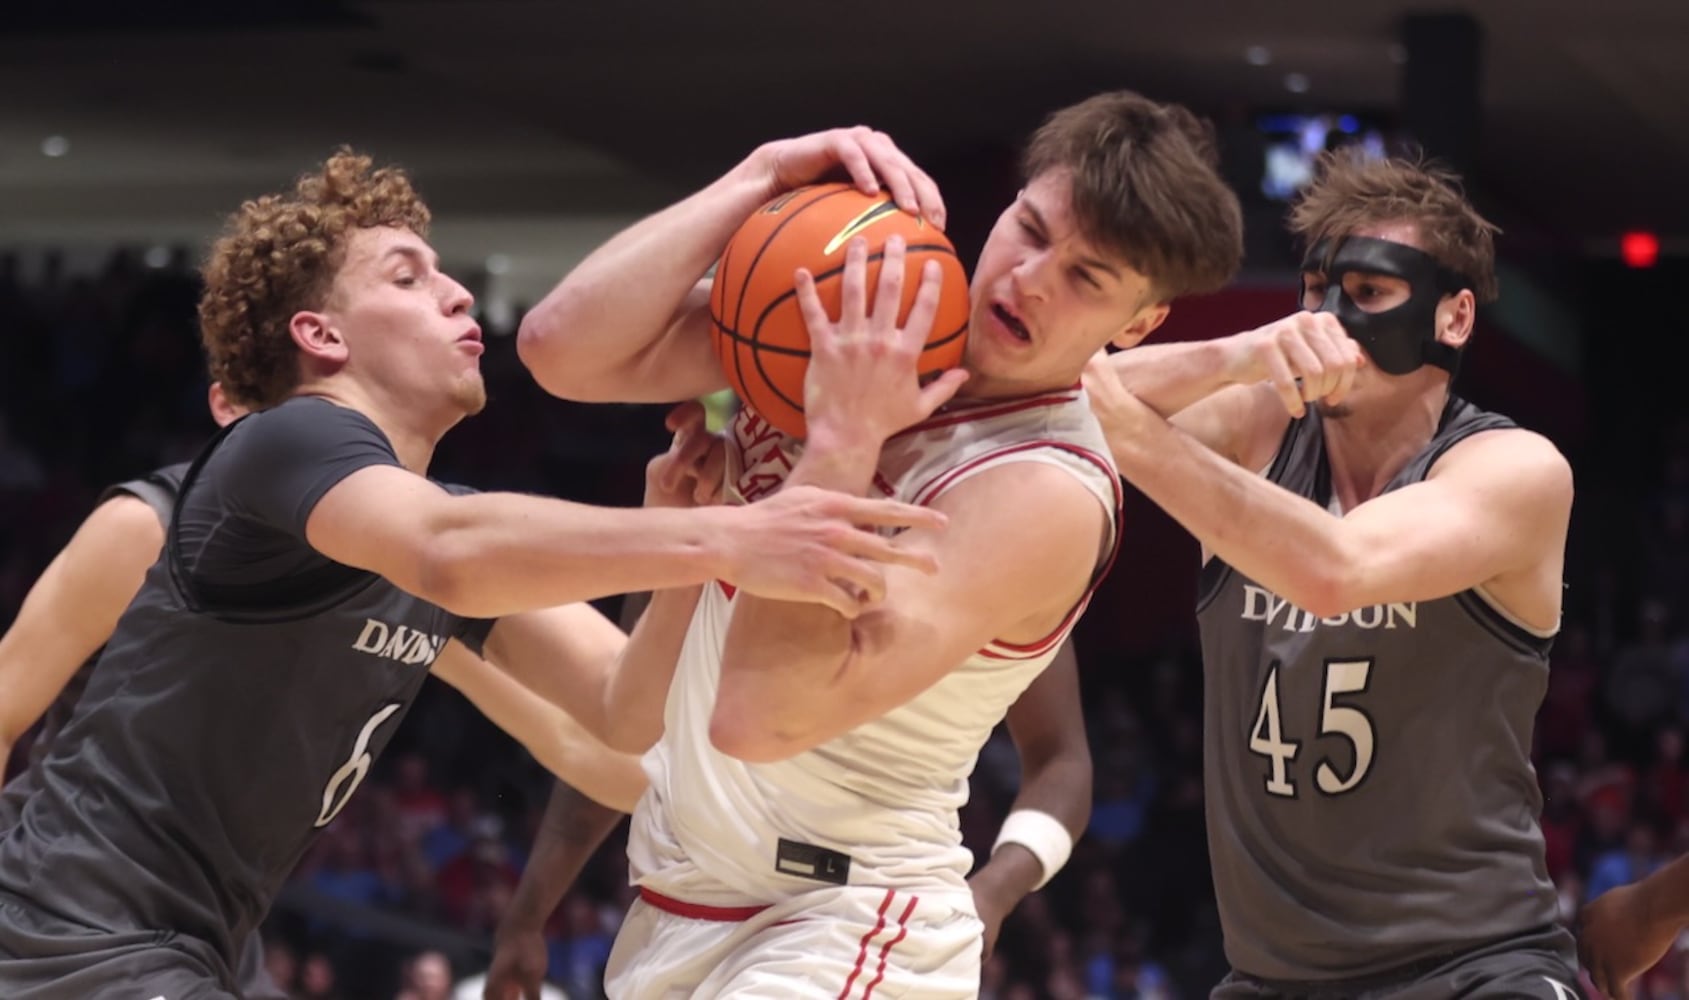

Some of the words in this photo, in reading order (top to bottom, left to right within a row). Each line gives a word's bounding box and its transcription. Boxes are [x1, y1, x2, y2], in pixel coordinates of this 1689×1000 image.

[313, 703, 400, 828] 6
[1249, 660, 1374, 796] 45
[826, 857, 835, 873] L
